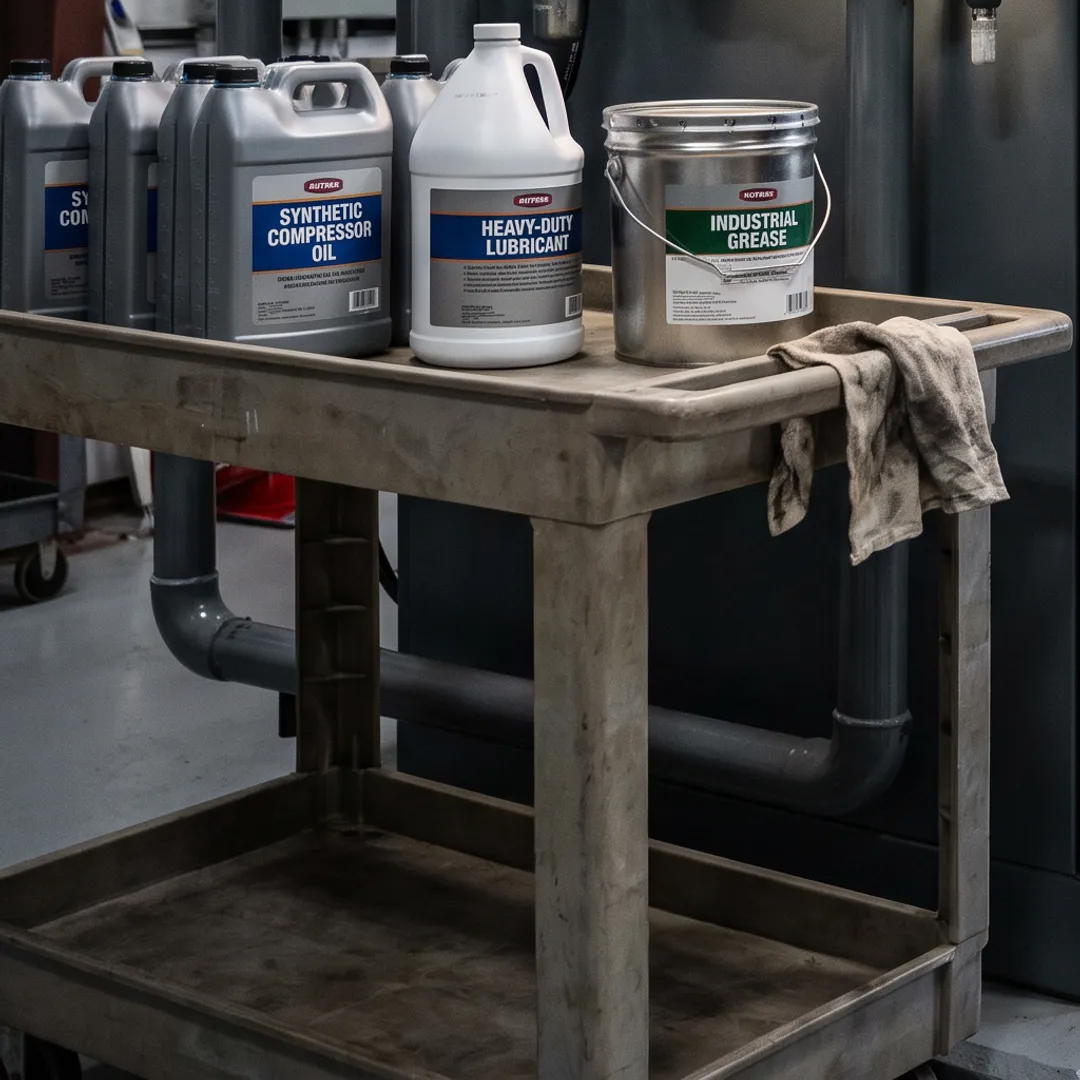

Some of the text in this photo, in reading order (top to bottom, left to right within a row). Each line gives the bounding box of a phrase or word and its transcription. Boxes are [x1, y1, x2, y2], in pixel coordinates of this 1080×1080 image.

[279, 202, 363, 226] SYNTHETIC
[710, 210, 799, 232] INDUSTRIAL
[267, 220, 372, 247] COMPRESSOR
[481, 215, 574, 237] HEAVY-DUTY
[486, 234, 570, 256] LUBRICANT
[727, 229, 787, 250] GREASE
[311, 244, 337, 262] OIL
